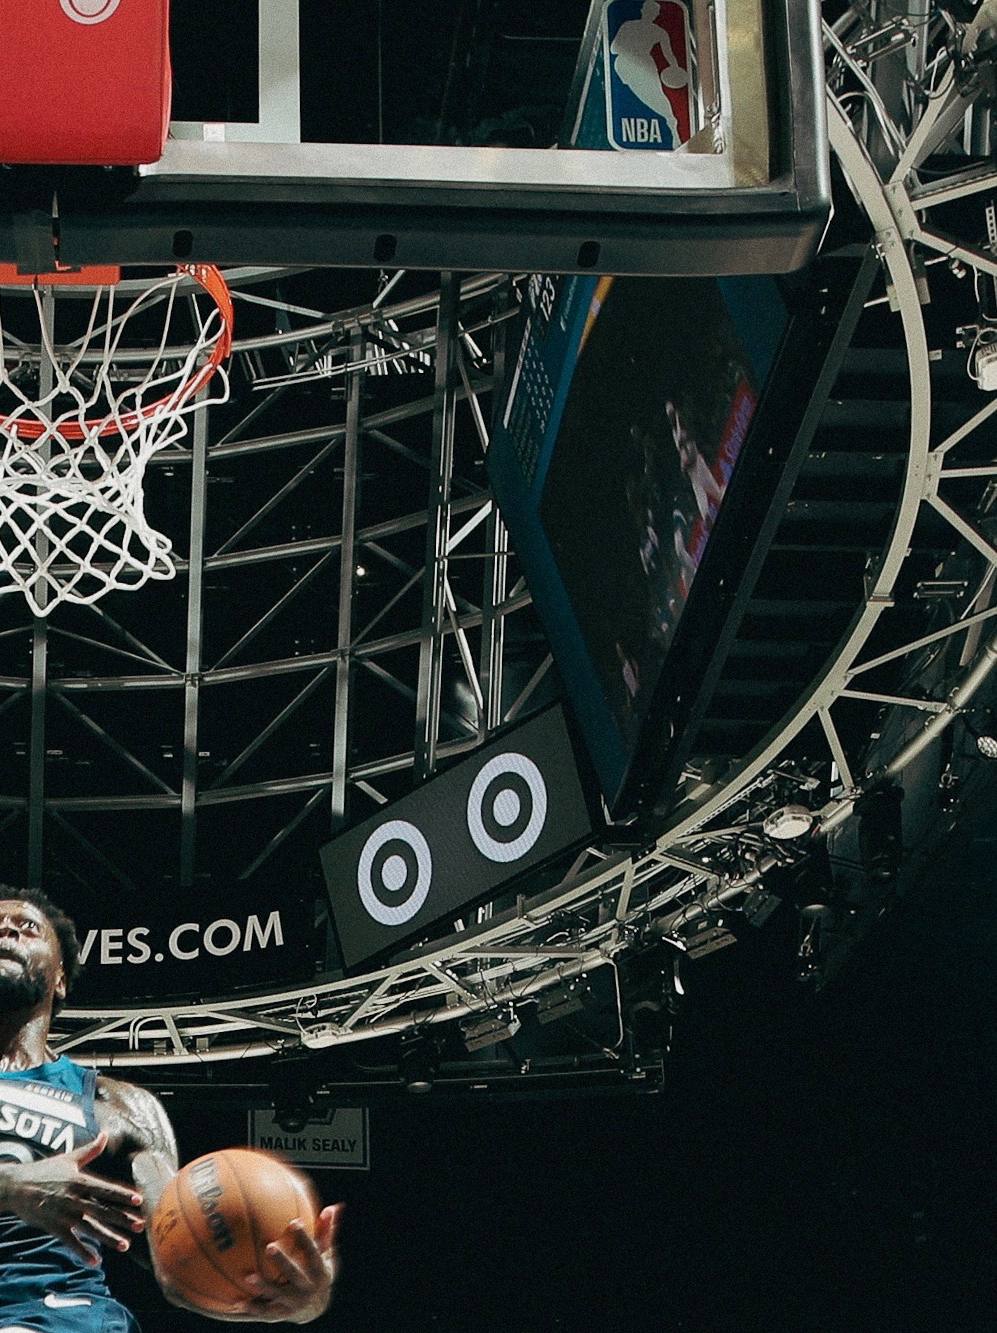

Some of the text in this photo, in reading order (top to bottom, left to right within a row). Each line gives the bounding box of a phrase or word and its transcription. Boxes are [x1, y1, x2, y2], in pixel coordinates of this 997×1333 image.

[621, 117, 663, 143] NBA
[259, 1136, 357, 1152] MALIK SEALY
